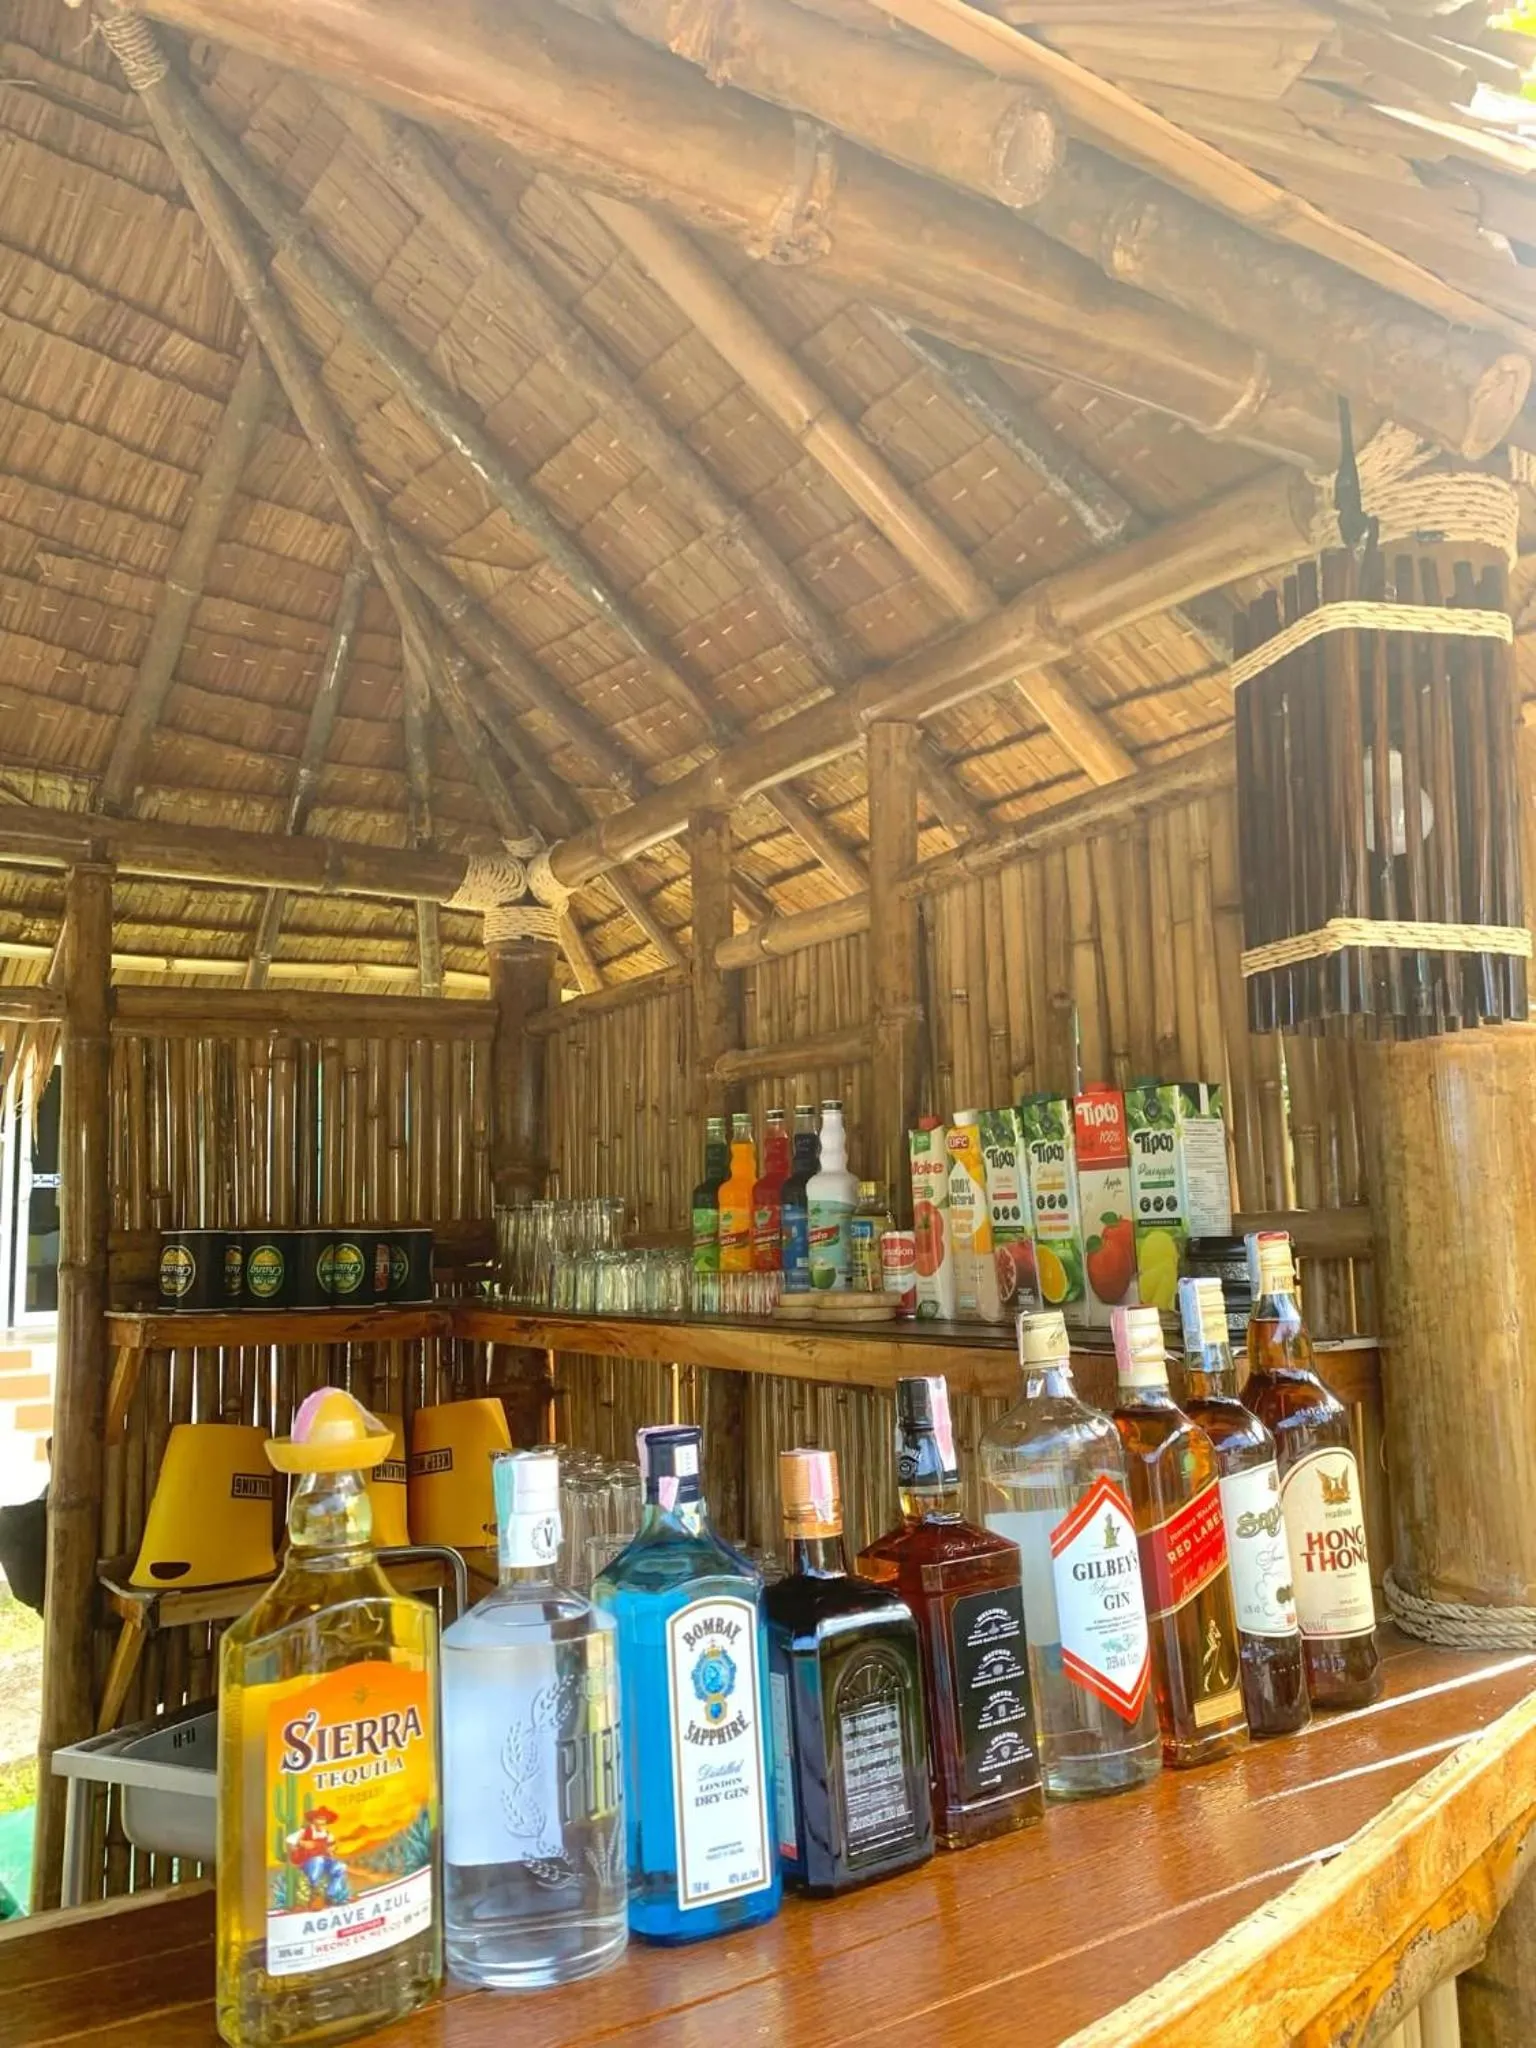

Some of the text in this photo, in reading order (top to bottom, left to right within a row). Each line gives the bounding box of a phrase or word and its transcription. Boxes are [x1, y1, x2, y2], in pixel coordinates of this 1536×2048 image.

[1076, 1101, 1119, 1127] Tipco
[949, 1136, 969, 1149] UFC
[1031, 1143, 1064, 1164] Tipco
[1133, 1131, 1174, 1154] Tipco
[985, 1147, 1015, 1169] Tipco
[1103, 1176, 1122, 1189] Apple
[1167, 1538, 1191, 1564] RED
[1193, 1508, 1224, 1543] LABEL
[1103, 1591, 1131, 1611] GIN
[681, 1617, 742, 1652] BOMBAY
[281, 1706, 423, 1772] SIERRA
[684, 1709, 751, 1747] SAPPHIRE
[316, 1757, 403, 1789] TEQUILA
[695, 1785, 750, 1808] DRY GIN
[699, 1777, 743, 1793] LONDON
[302, 1907, 365, 1935] AGAVE
[371, 1892, 411, 1917] AZUL
